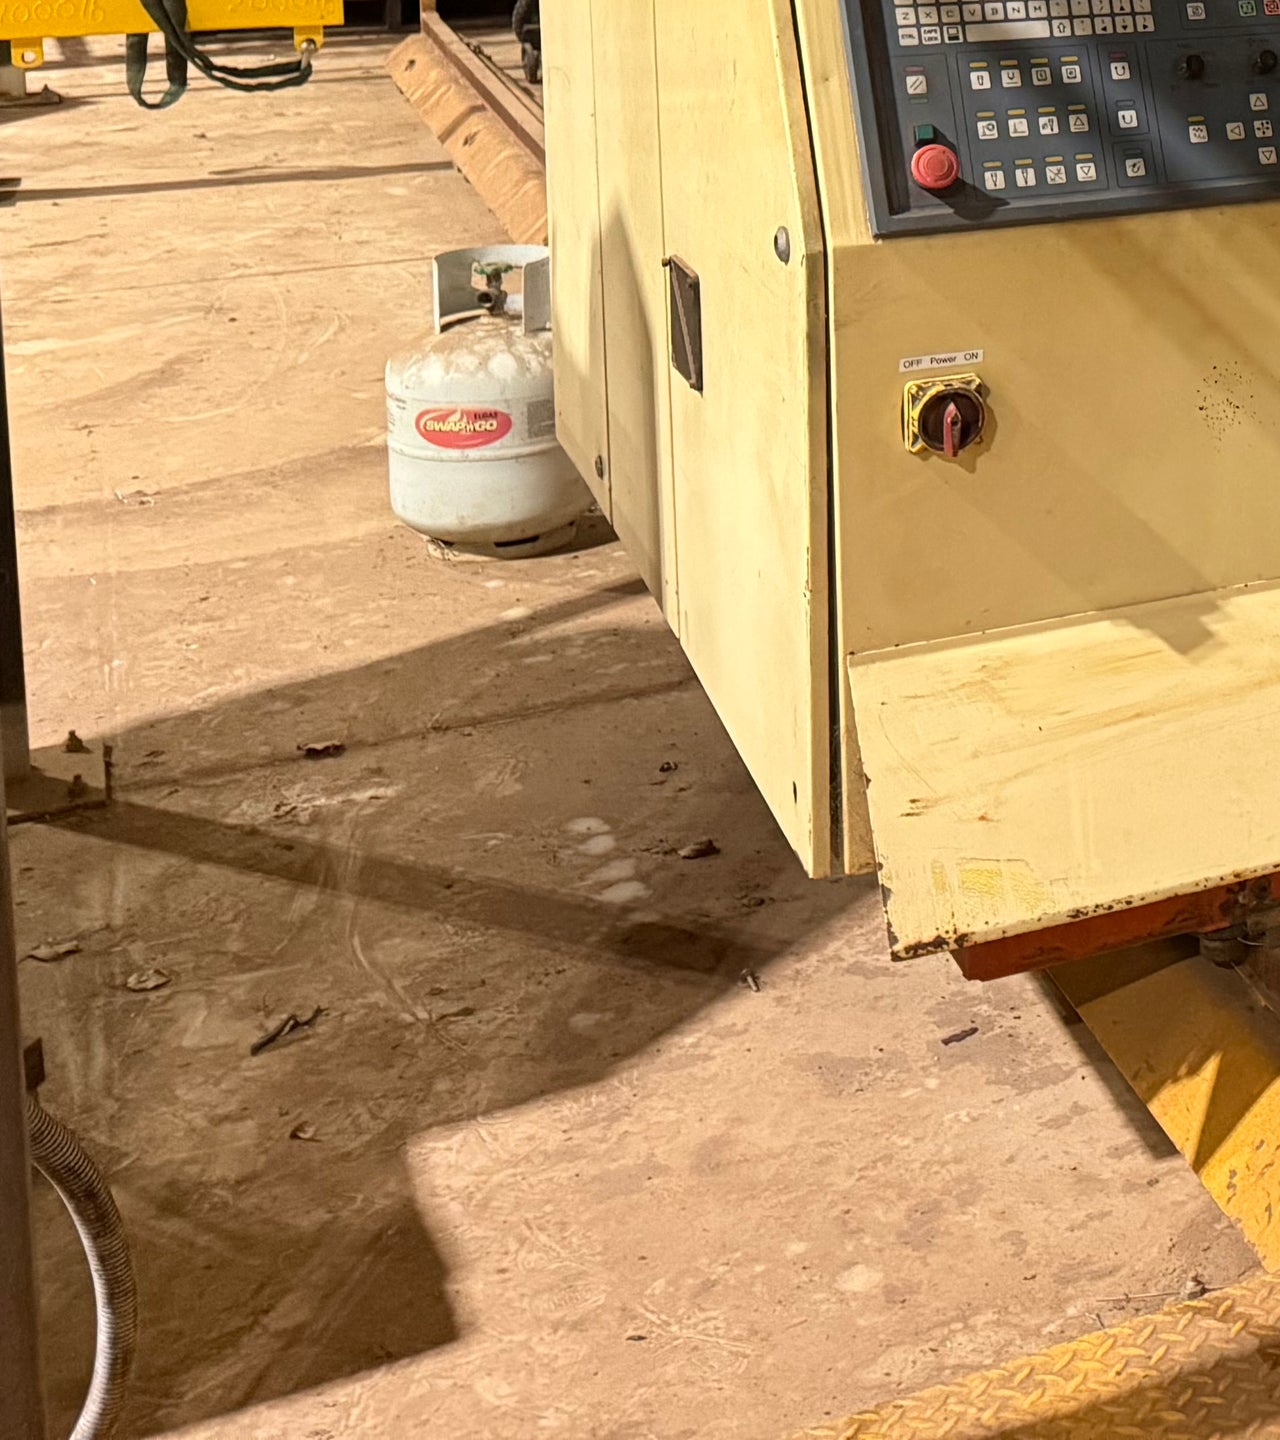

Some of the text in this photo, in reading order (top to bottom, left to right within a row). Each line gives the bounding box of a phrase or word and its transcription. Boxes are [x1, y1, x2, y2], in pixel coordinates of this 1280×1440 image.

[903, 351, 979, 369] OFF Power ON
